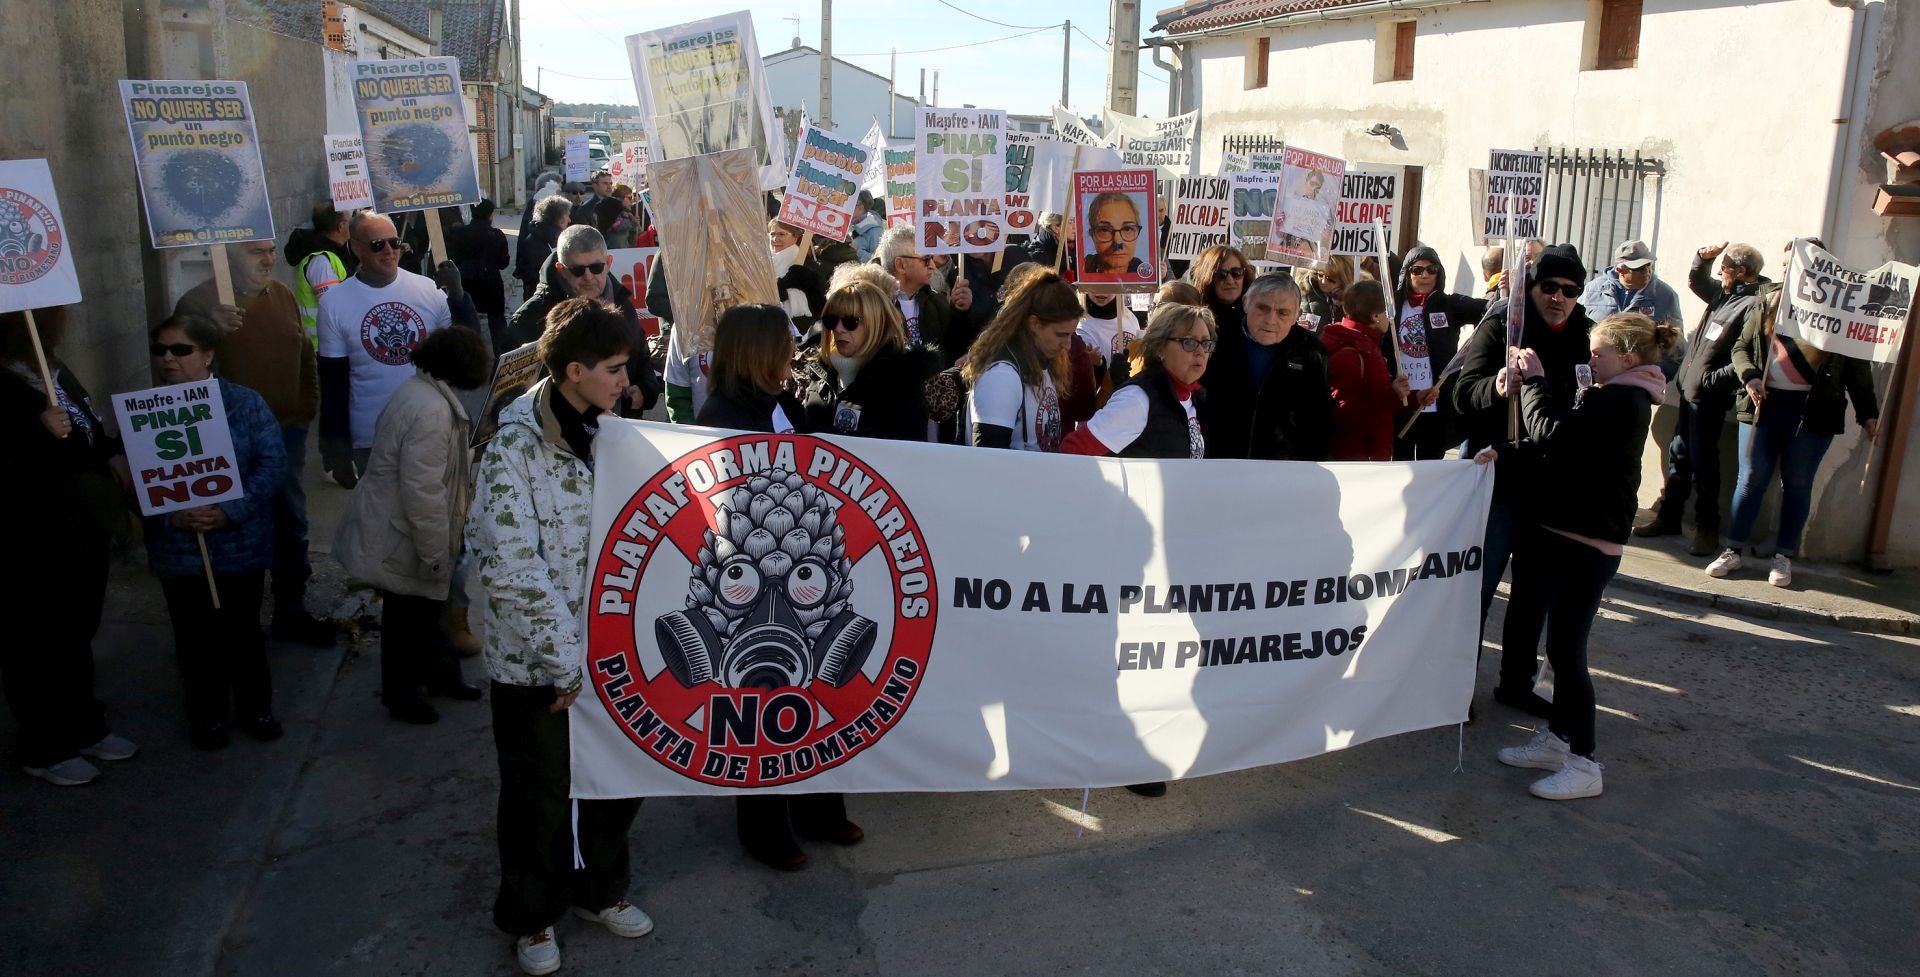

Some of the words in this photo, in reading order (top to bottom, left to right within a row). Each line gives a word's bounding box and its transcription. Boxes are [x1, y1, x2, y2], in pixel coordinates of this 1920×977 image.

[357, 61, 448, 76] Pinarejos
[132, 83, 237, 97] Pinarejos
[358, 80, 378, 98] NO
[380, 78, 427, 98] QUIERE
[428, 76, 452, 94] SER
[133, 100, 157, 118] NO
[160, 100, 213, 120] QUIERE
[215, 100, 243, 118] SER
[402, 98, 417, 107] un
[184, 122, 202, 131] un
[370, 108, 410, 126] punto
[414, 105, 452, 121] negro
[925, 112, 969, 131] Mapfre
[978, 114, 999, 129] IAM
[148, 131, 195, 149] punto
[200, 132, 244, 148] negro
[806, 127, 868, 164] Nuestro
[926, 133, 998, 154] PINAR
[802, 144, 864, 175] pueblo
[1252, 154, 1269, 163] Mapfre
[1252, 162, 1282, 170] PINAR
[1286, 150, 1304, 166] POR
[1305, 154, 1316, 168] LA
[1317, 157, 1344, 174] SALUD
[1490, 150, 1544, 174] INCOMPETENTE
[795, 160, 856, 196] Nuestro
[1080, 176, 1100, 188] POR
[1102, 175, 1114, 187] LA
[1116, 174, 1148, 186] SALUD
[1236, 176, 1264, 184] Mapfre
[1342, 172, 1395, 199] ENTIROSO
[1488, 174, 1542, 196] MENTIROSO
[394, 197, 410, 208] en
[412, 194, 424, 206] el
[428, 193, 462, 206] mapa
[797, 176, 848, 208] hogar
[787, 196, 845, 227] NO
[922, 198, 1002, 218] PLANTA
[1176, 204, 1228, 226] ALCALDE
[1488, 195, 1538, 215] ALCLDE
[1005, 209, 1034, 228] O
[176, 230, 194, 241] en
[199, 228, 212, 240] el
[215, 228, 254, 240] mapa
[924, 220, 1000, 248] NO
[1811, 256, 1866, 284] MAPFRE
[1878, 272, 1899, 290] IAM
[1796, 269, 1862, 313] ESTE
[1788, 304, 1842, 334] PROYECTO
[1846, 320, 1890, 342] HUELE
[390, 347, 408, 358] NO
[124, 394, 174, 412] Mapfre
[184, 386, 210, 402] IAM
[130, 403, 213, 432] PINAR
[140, 456, 231, 484] PLANTA
[147, 474, 234, 508] NO
[598, 440, 797, 616] PLATAFORMA
[807, 446, 930, 620] PINAREJOS
[952, 576, 1012, 611] NO
[1020, 581, 1052, 614] A
[1061, 583, 1108, 614] LA
[1119, 583, 1257, 614] PLANTA
[1264, 579, 1308, 608] DE
[1118, 641, 1166, 672] EN
[1176, 624, 1368, 669] PINAREJOS
[596, 650, 698, 769] PLANTA
[700, 749, 750, 782] DE
[758, 656, 919, 782] BIOMETANO
[708, 692, 813, 748] NO
